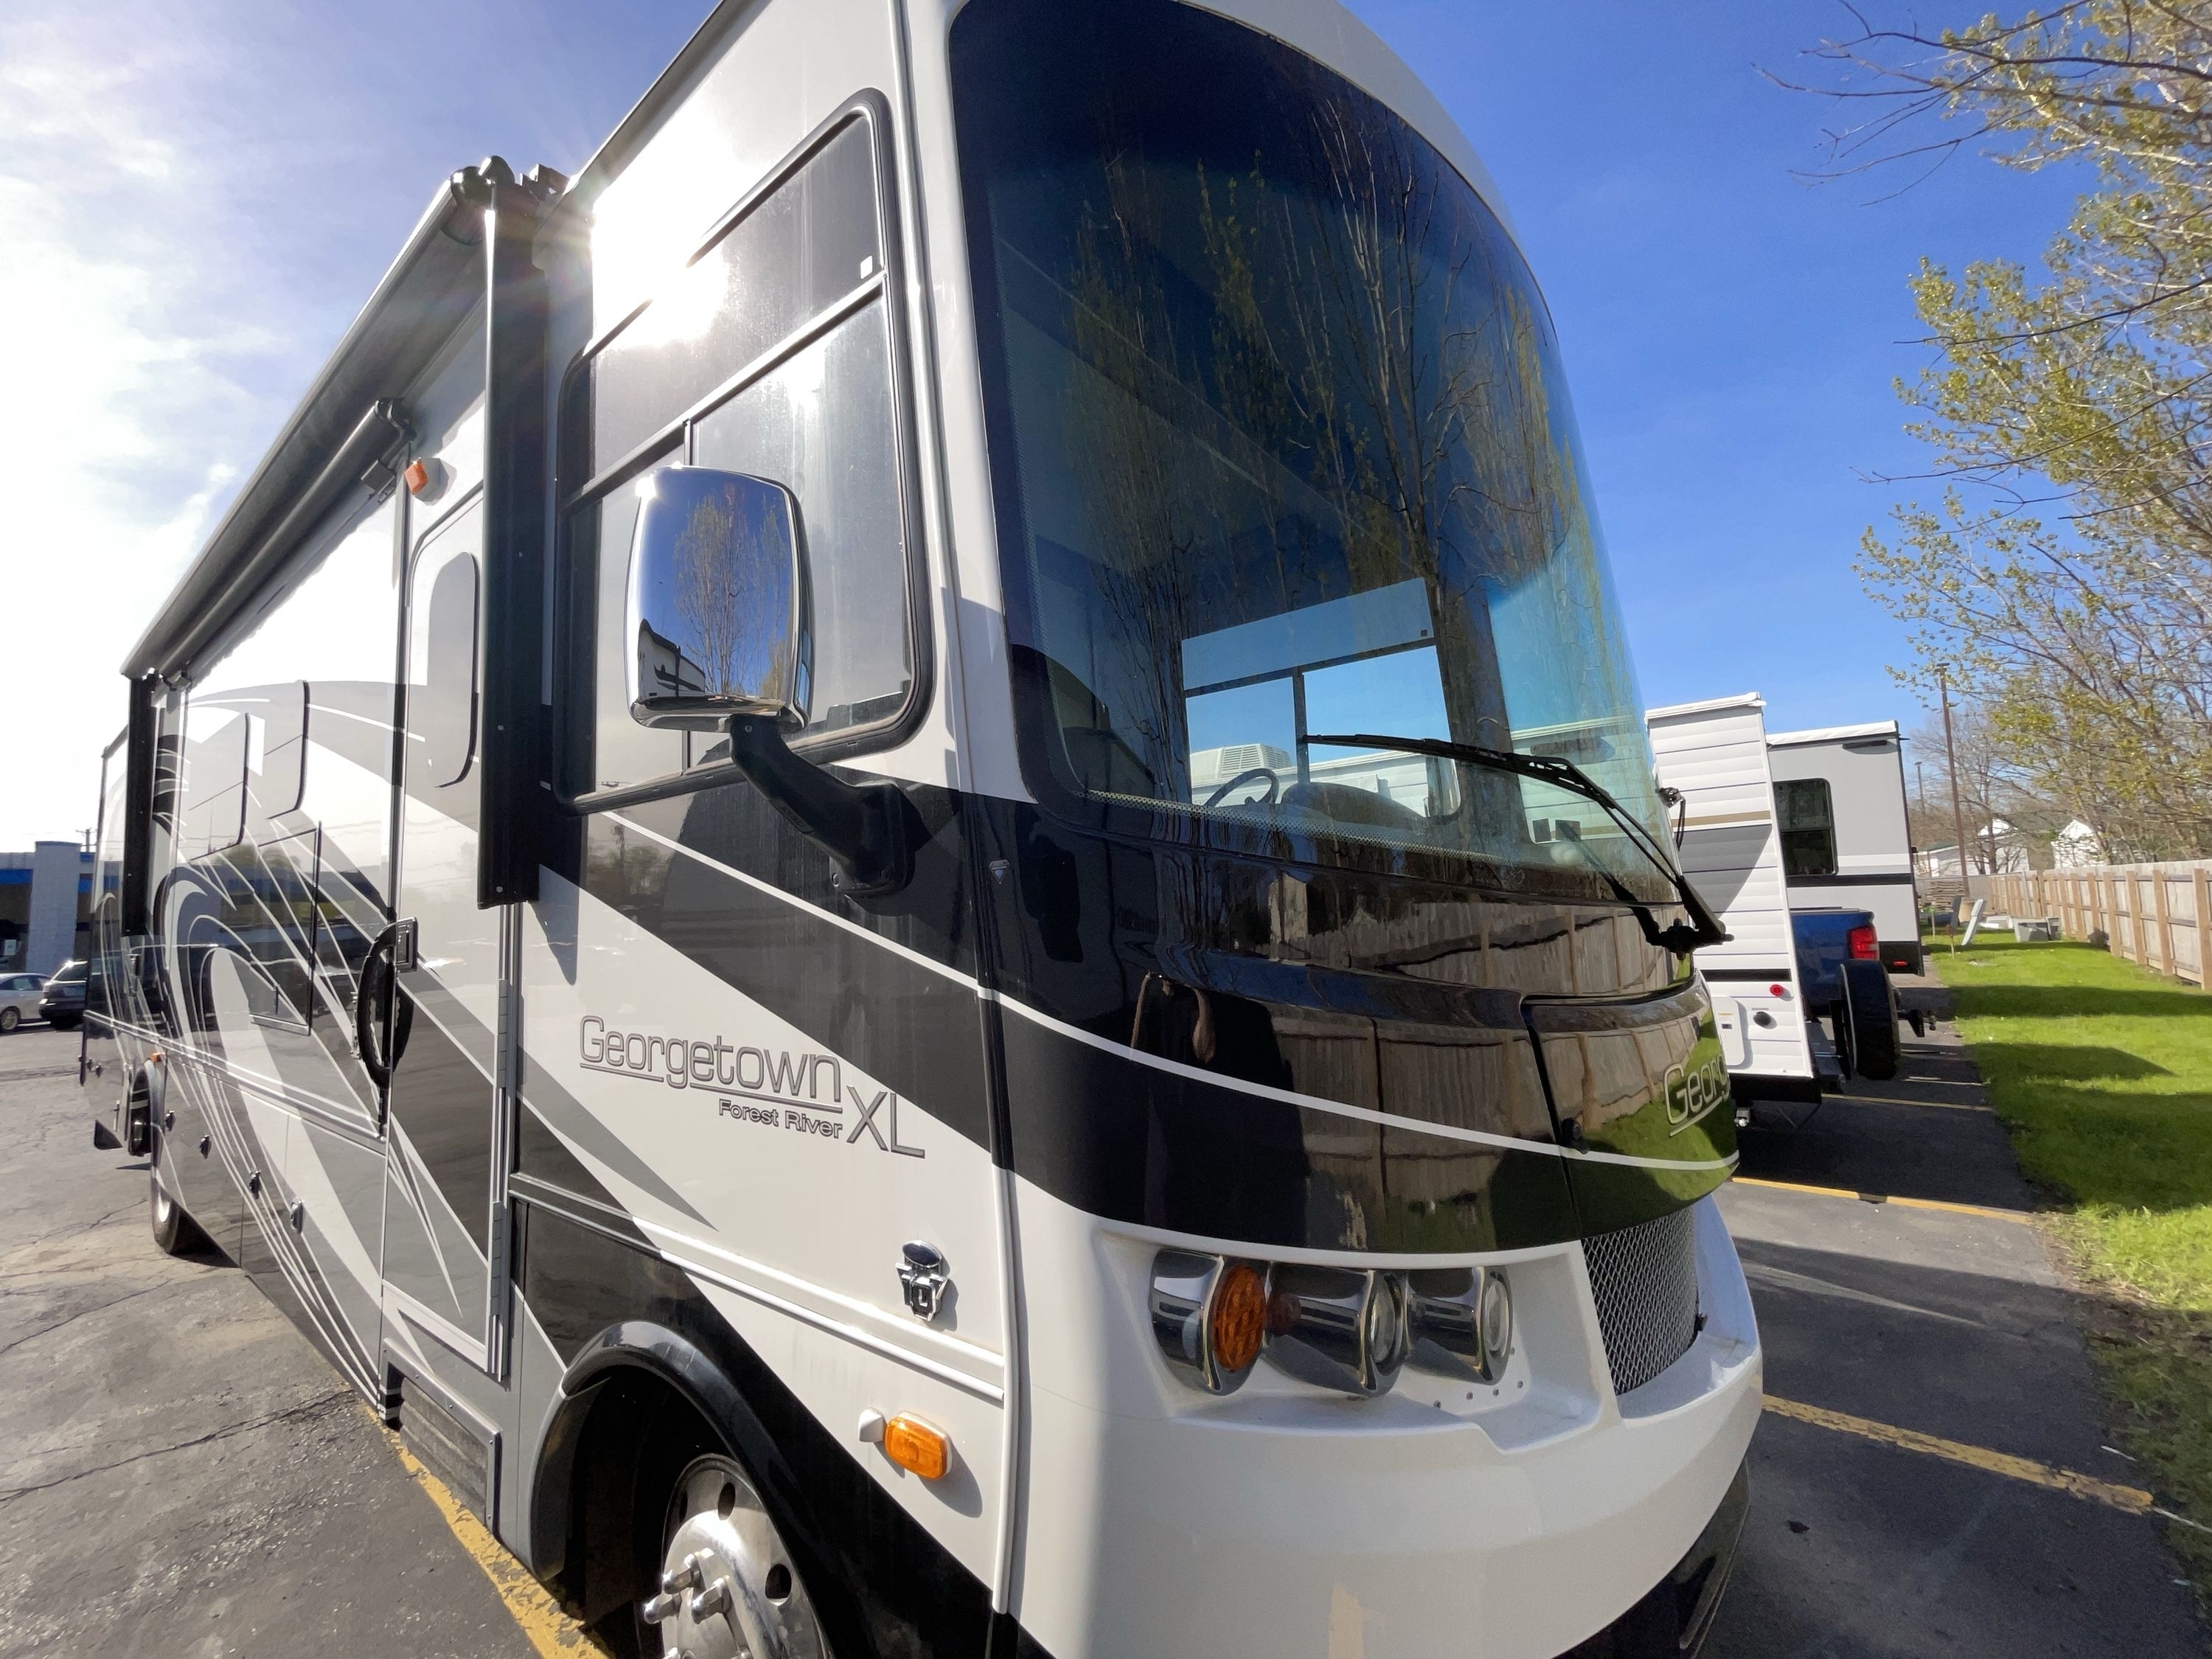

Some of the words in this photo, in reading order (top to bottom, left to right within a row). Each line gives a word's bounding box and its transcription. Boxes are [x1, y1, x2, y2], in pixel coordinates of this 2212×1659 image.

[580, 1015, 841, 1102] Georgetown
[846, 1085, 925, 1158] XL
[719, 1099, 779, 1127] Forest
[785, 1110, 843, 1138] River
